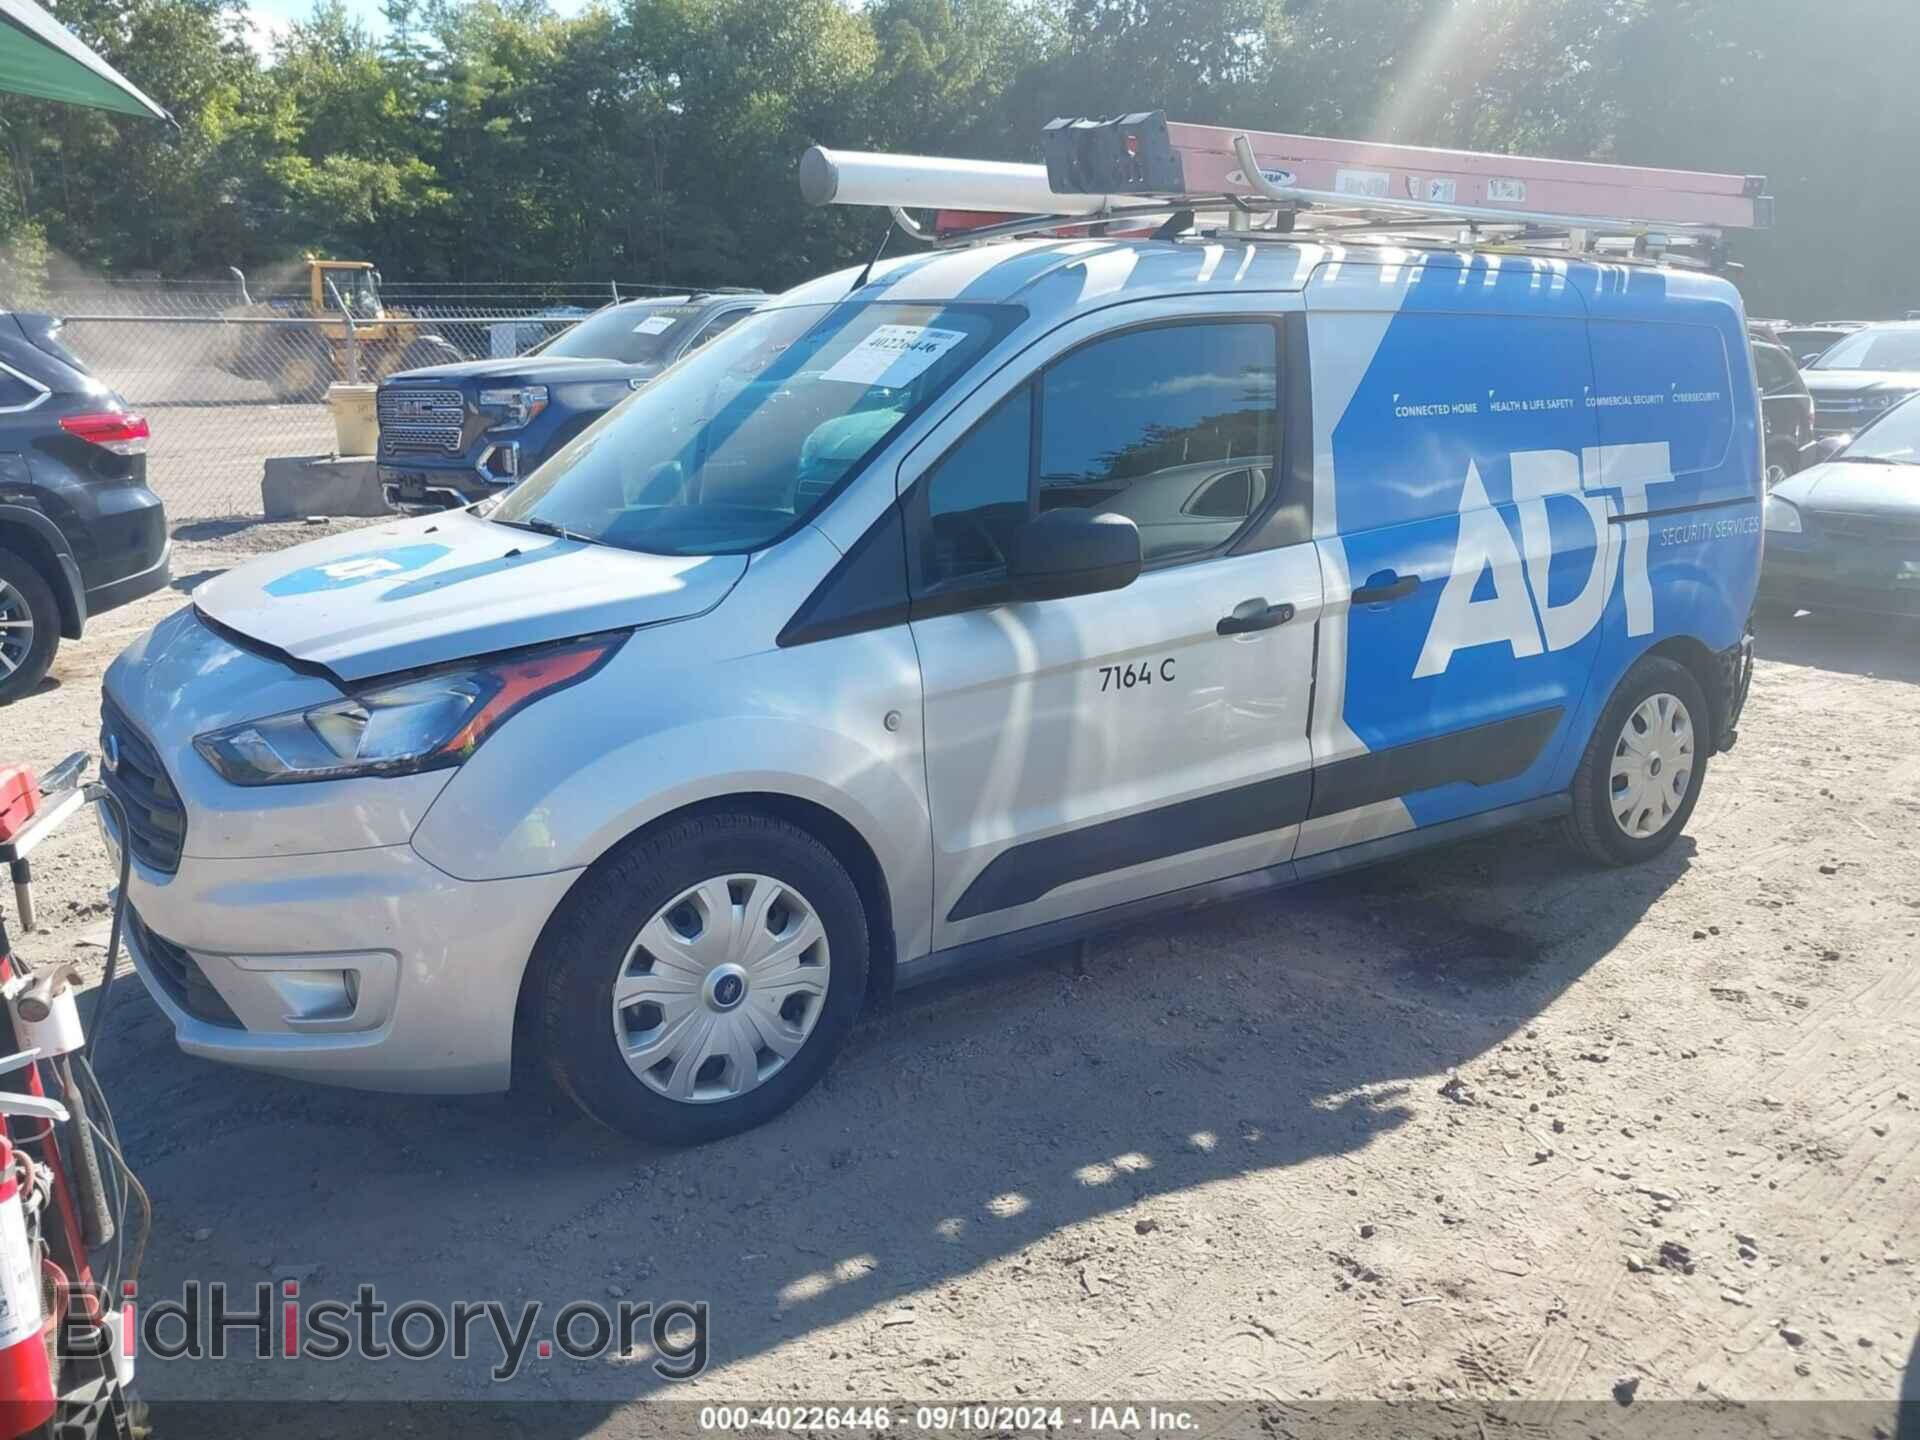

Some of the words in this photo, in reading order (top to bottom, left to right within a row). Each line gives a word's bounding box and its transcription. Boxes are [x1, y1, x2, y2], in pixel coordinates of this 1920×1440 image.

[1395, 405, 1450, 418] CONNECTED
[1452, 402, 1479, 415] HOME
[1490, 400, 1520, 412] HEALTH
[1522, 400, 1529, 411] &
[1530, 400, 1545, 411] LIFE
[1546, 398, 1575, 409] SAFETY
[1633, 394, 1665, 406] SECURITY
[1660, 522, 1713, 546] SECURITY
[1715, 515, 1761, 538] SERVICES
[1412, 441, 1675, 679] ADT
[1099, 662, 1151, 692] 7164
[1160, 658, 1176, 682] C
